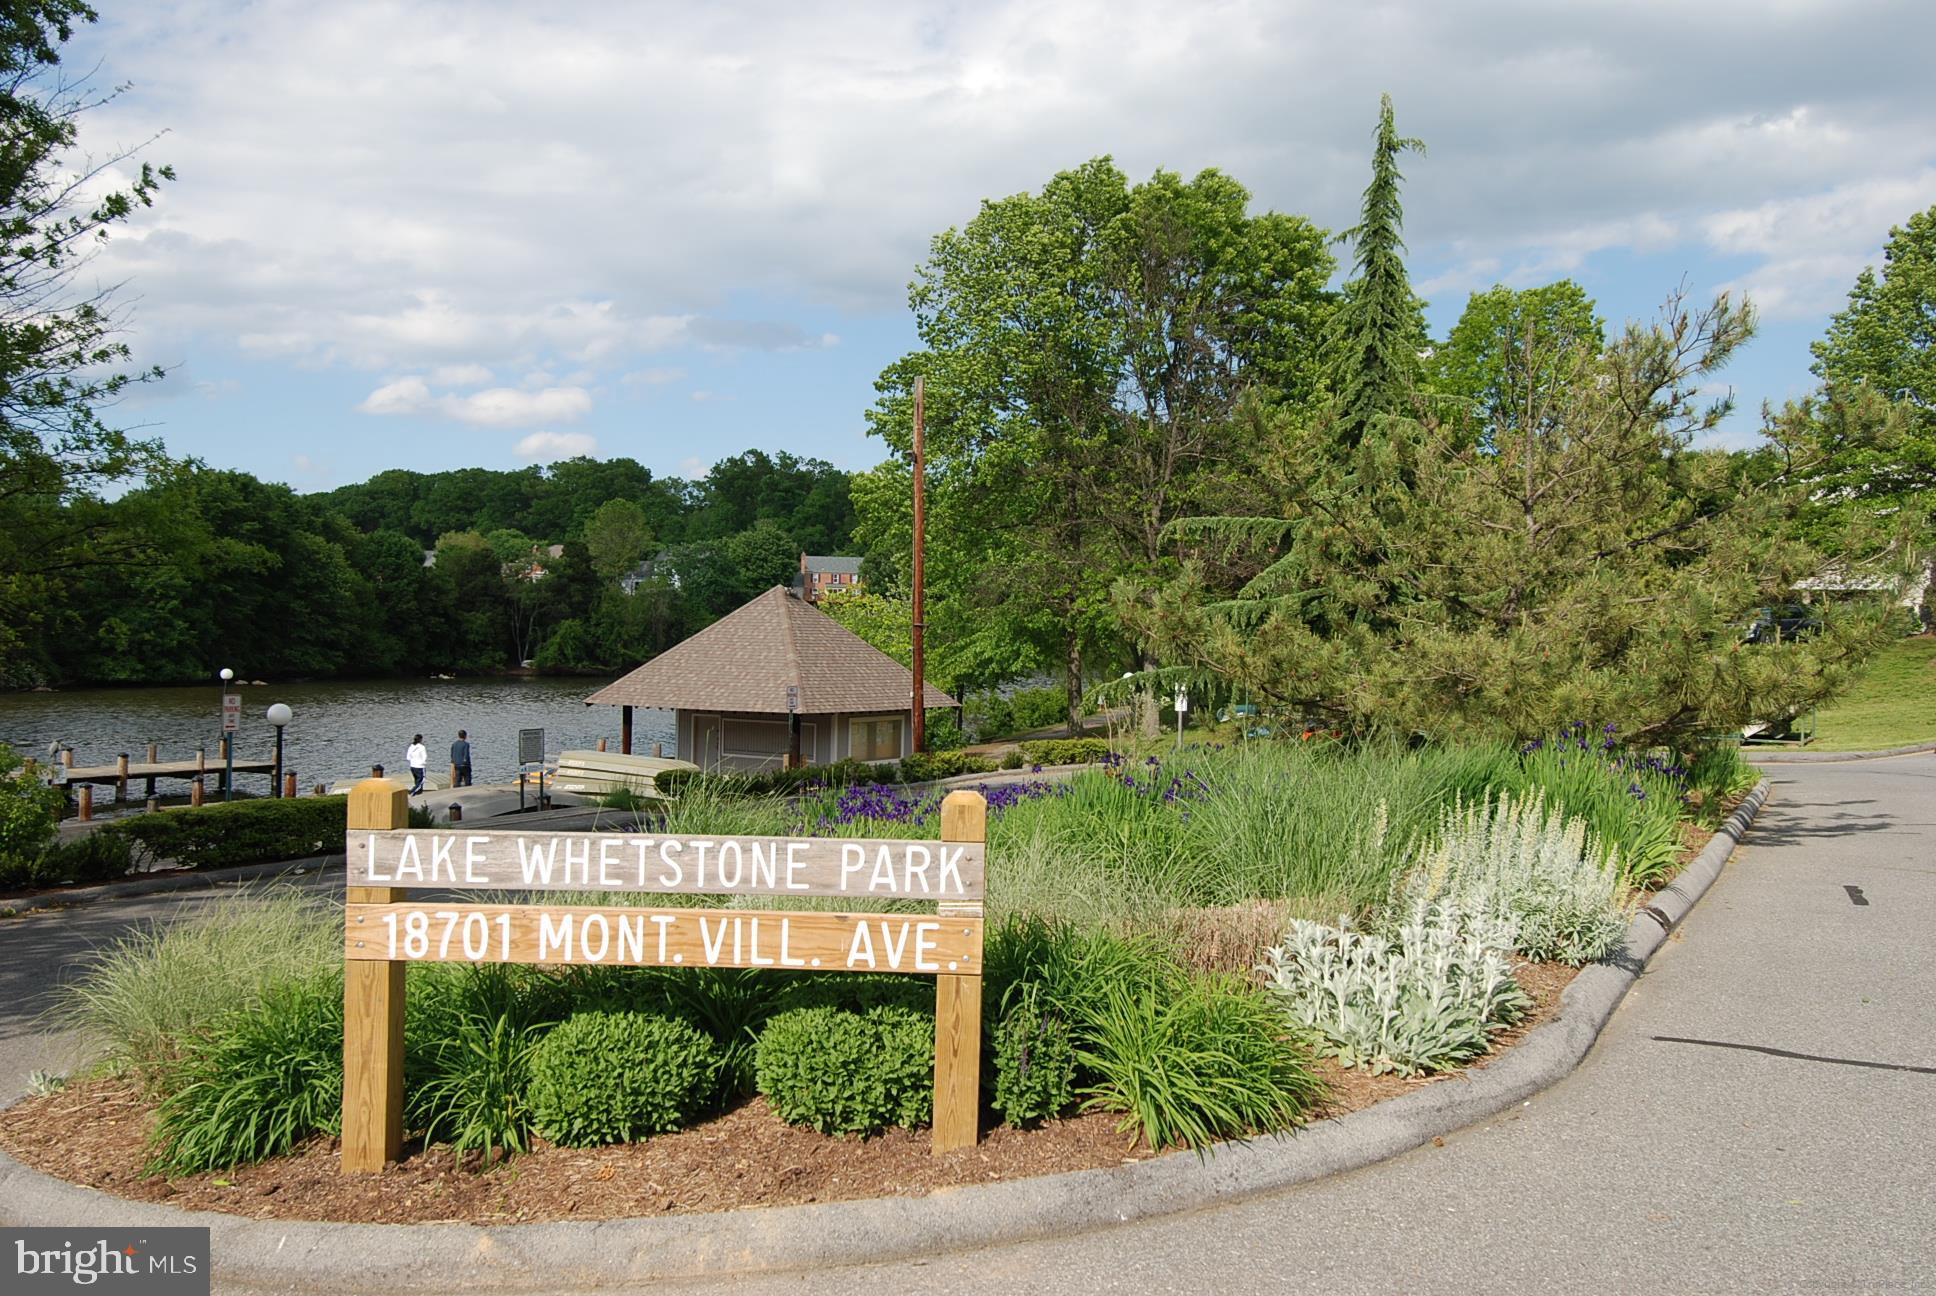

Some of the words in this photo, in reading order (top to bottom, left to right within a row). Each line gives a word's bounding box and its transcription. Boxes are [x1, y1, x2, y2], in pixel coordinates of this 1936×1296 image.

[367, 834, 490, 883] LAKE
[517, 837, 811, 890] WHETSTONE
[840, 843, 964, 894] PARK
[382, 911, 510, 960] 18701
[539, 913, 682, 964] MONT.
[700, 917, 821, 967] VILL.
[846, 920, 957, 970] AVE.
